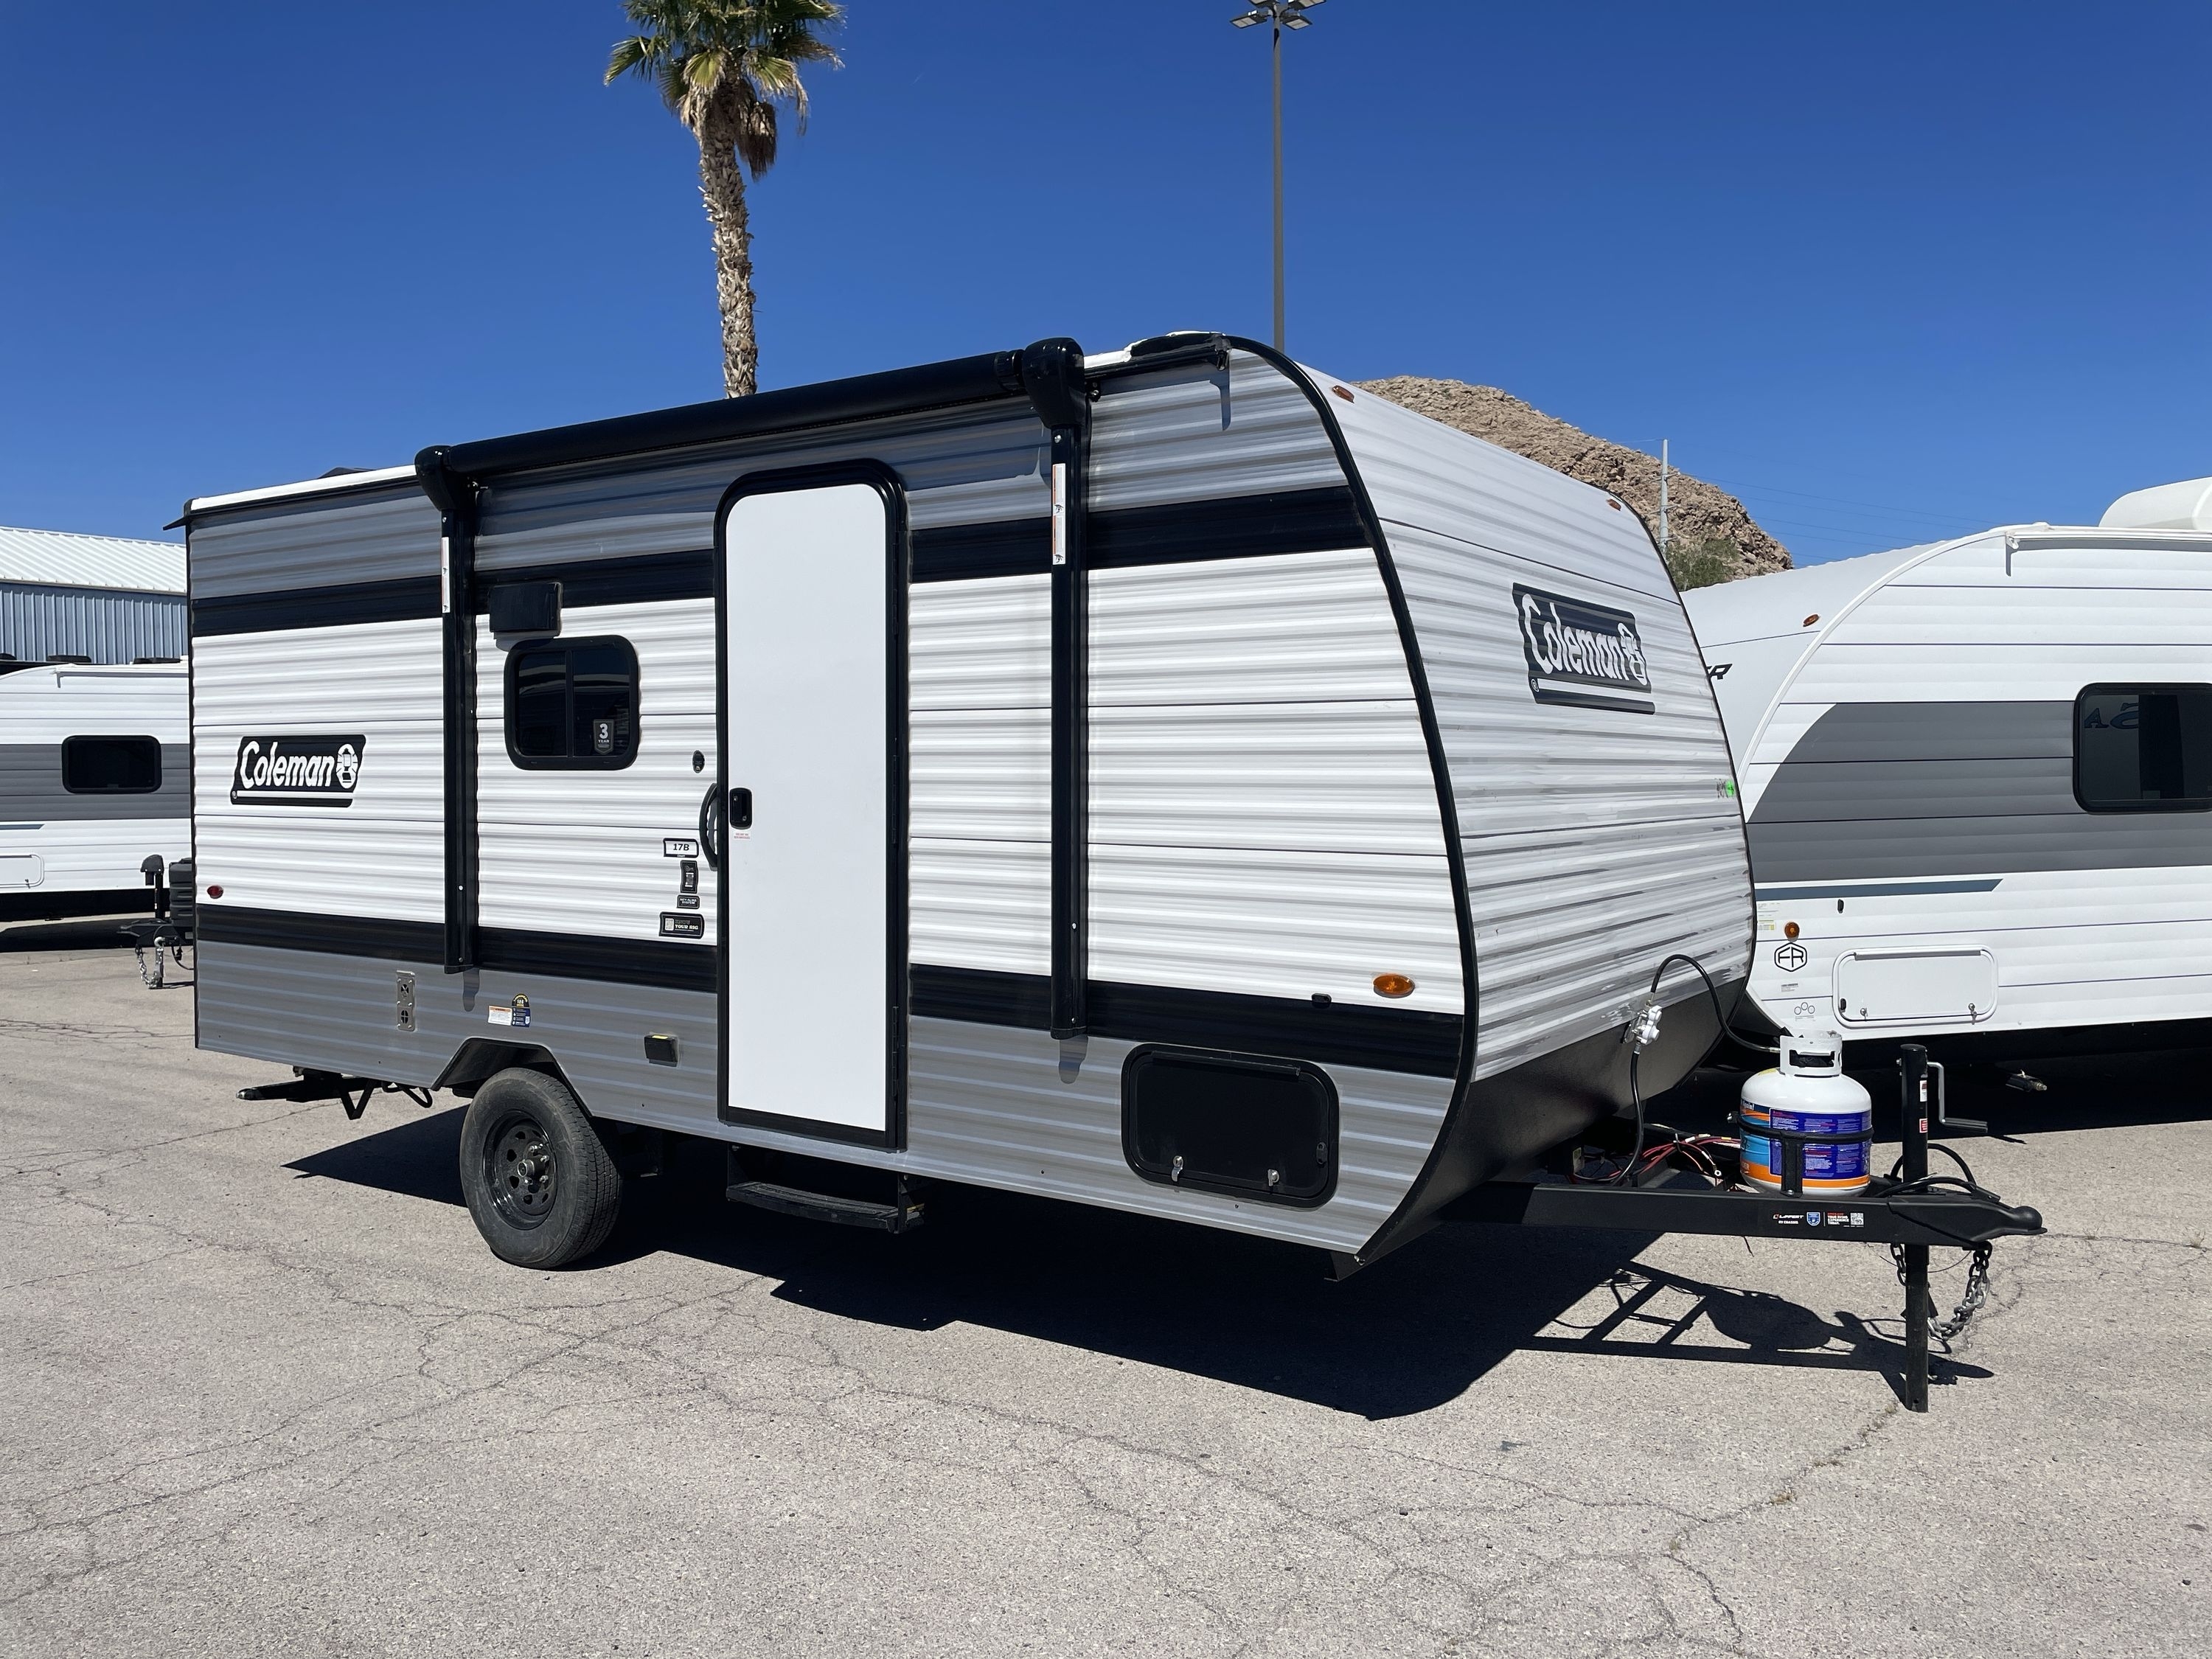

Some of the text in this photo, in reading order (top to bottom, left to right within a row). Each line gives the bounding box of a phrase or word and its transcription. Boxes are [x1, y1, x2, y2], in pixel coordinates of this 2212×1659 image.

[1522, 593, 1630, 681] Coleman
[599, 723, 608, 740] 3
[240, 740, 335, 789] Coleman
